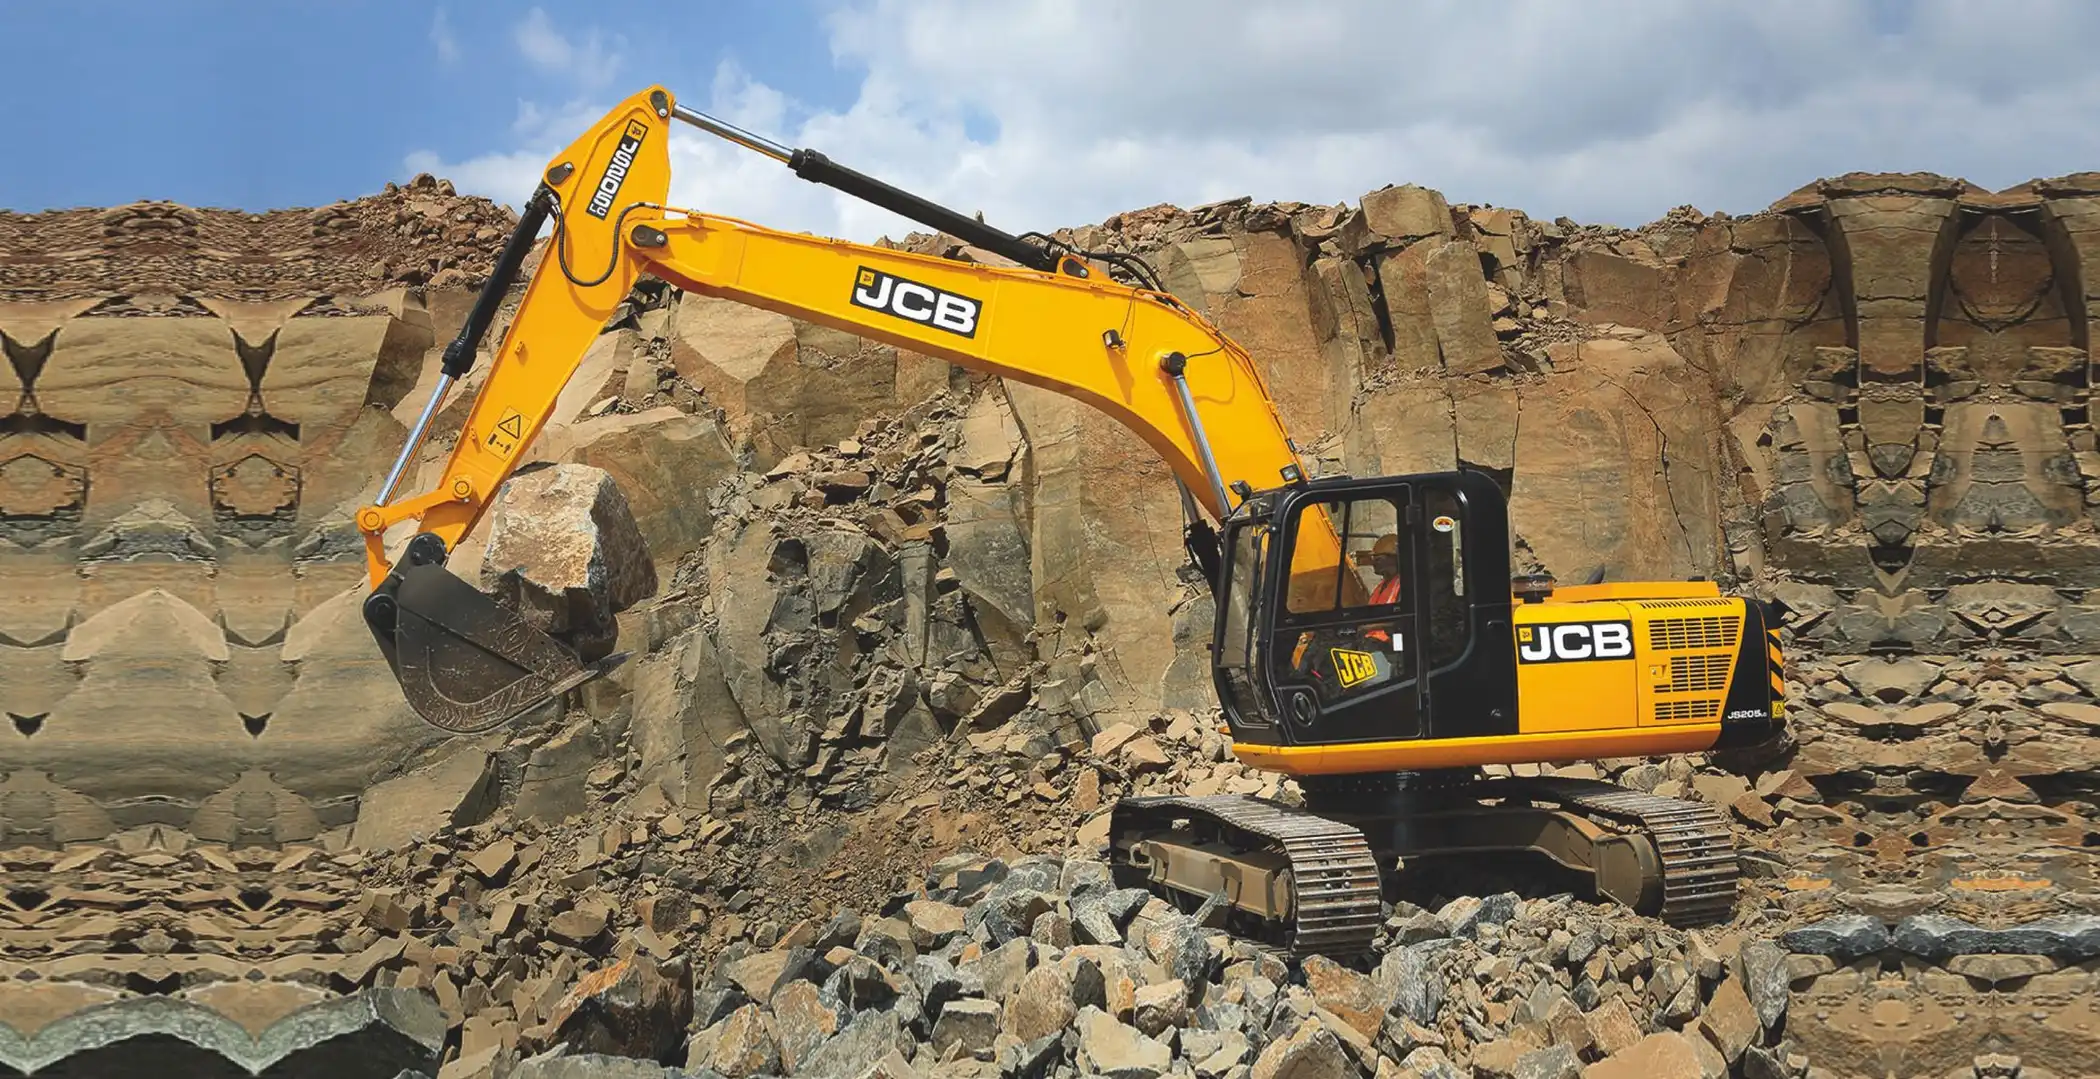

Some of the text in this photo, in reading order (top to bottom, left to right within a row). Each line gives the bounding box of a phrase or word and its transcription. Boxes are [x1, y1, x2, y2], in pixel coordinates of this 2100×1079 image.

[856, 276, 976, 333] JCB
[1520, 623, 1632, 661] JCB
[1339, 652, 1375, 684] JCB
